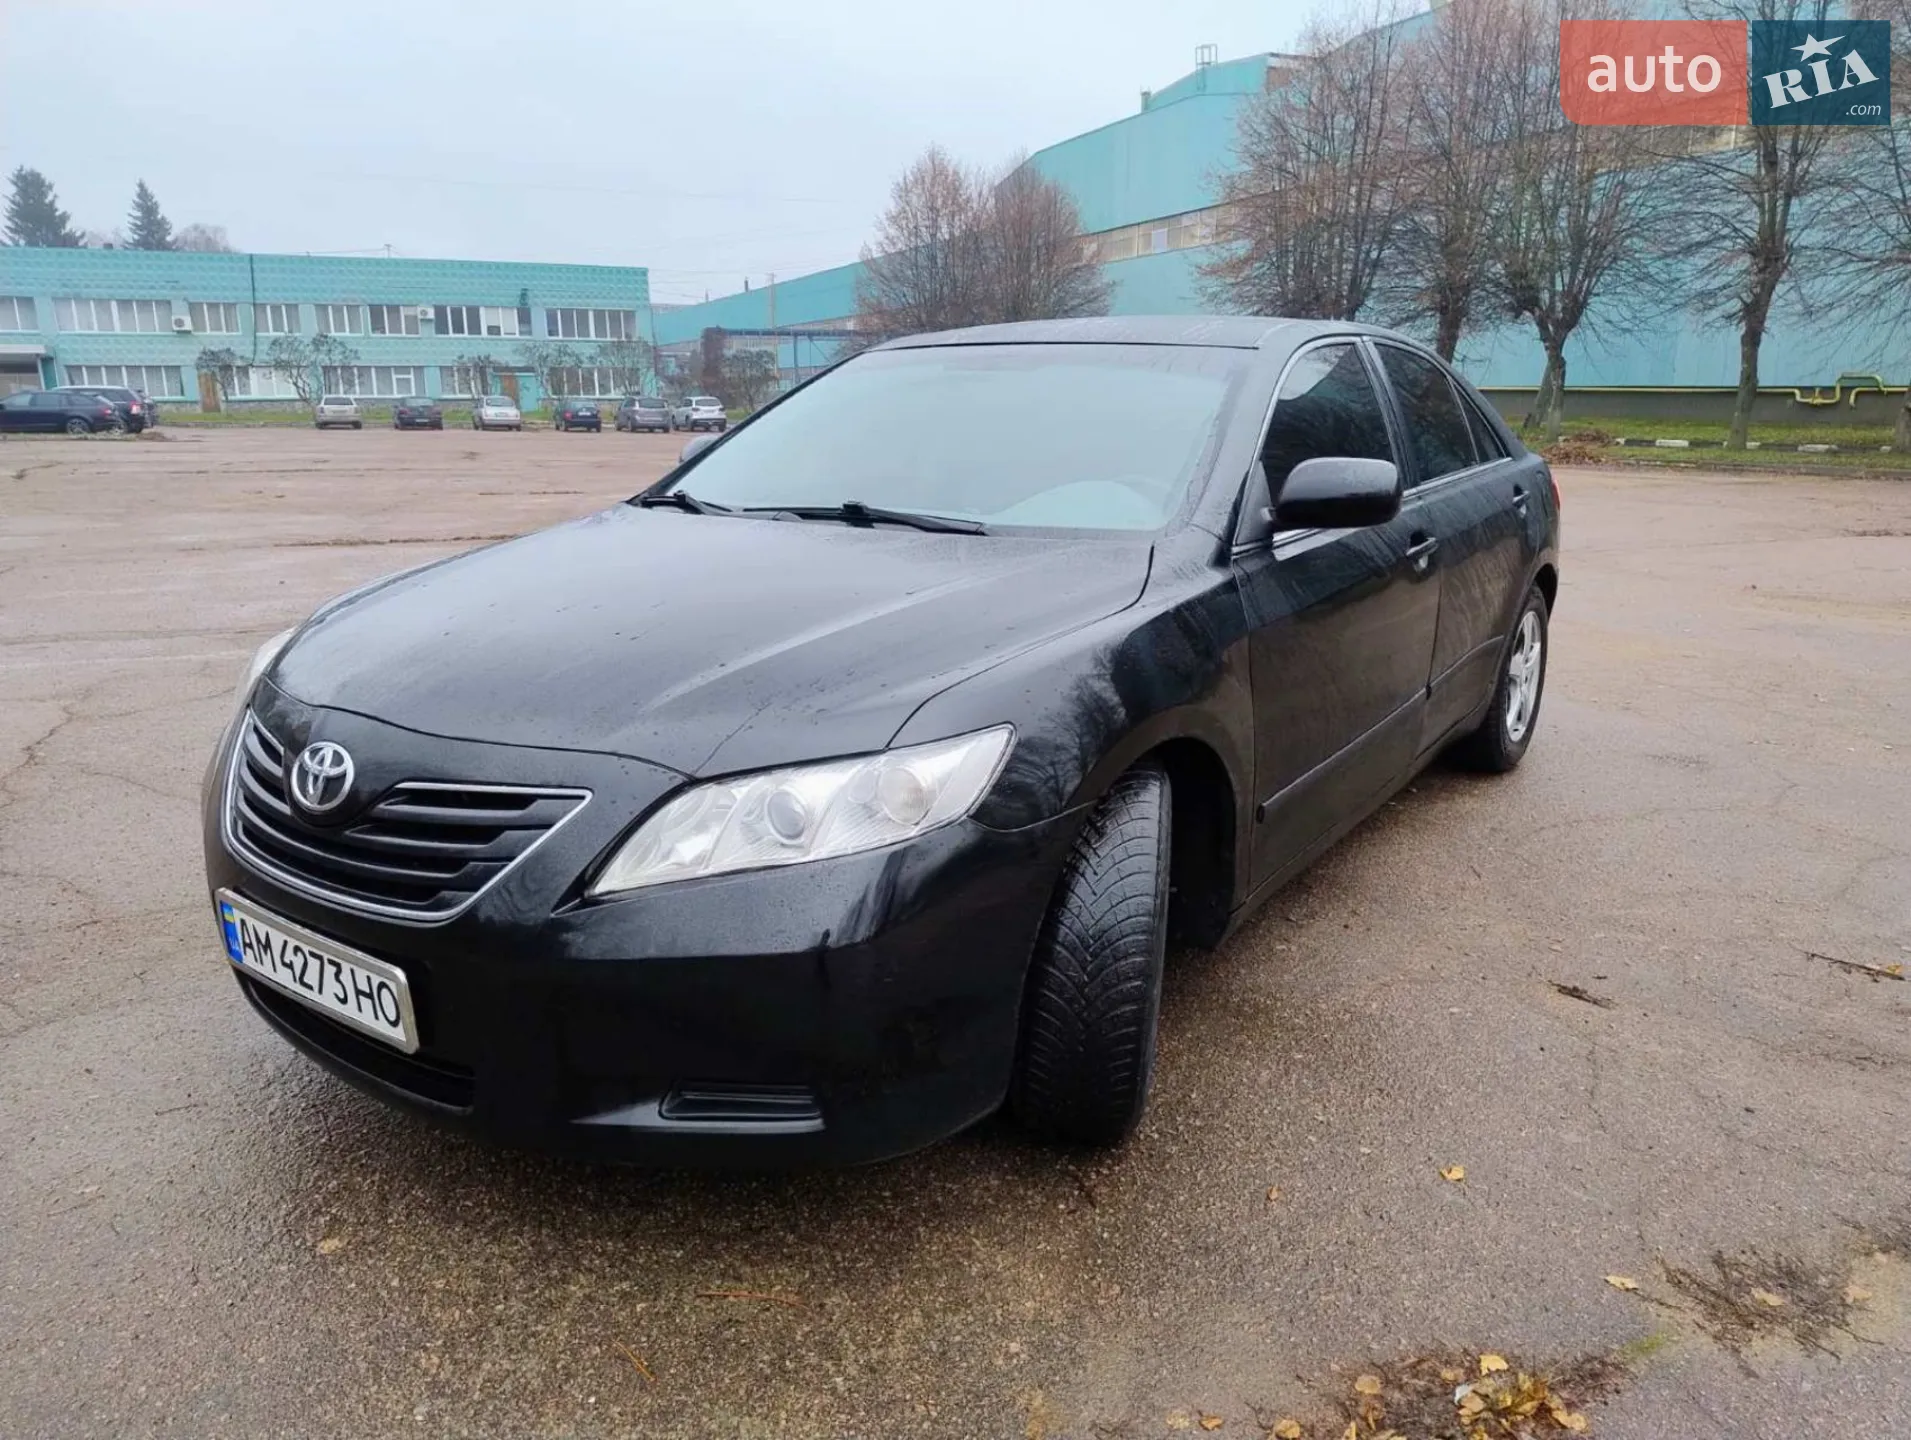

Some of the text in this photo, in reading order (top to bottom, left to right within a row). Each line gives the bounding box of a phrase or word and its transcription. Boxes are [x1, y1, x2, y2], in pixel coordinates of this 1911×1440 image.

[240, 918, 401, 1028] AM 4273 HO
